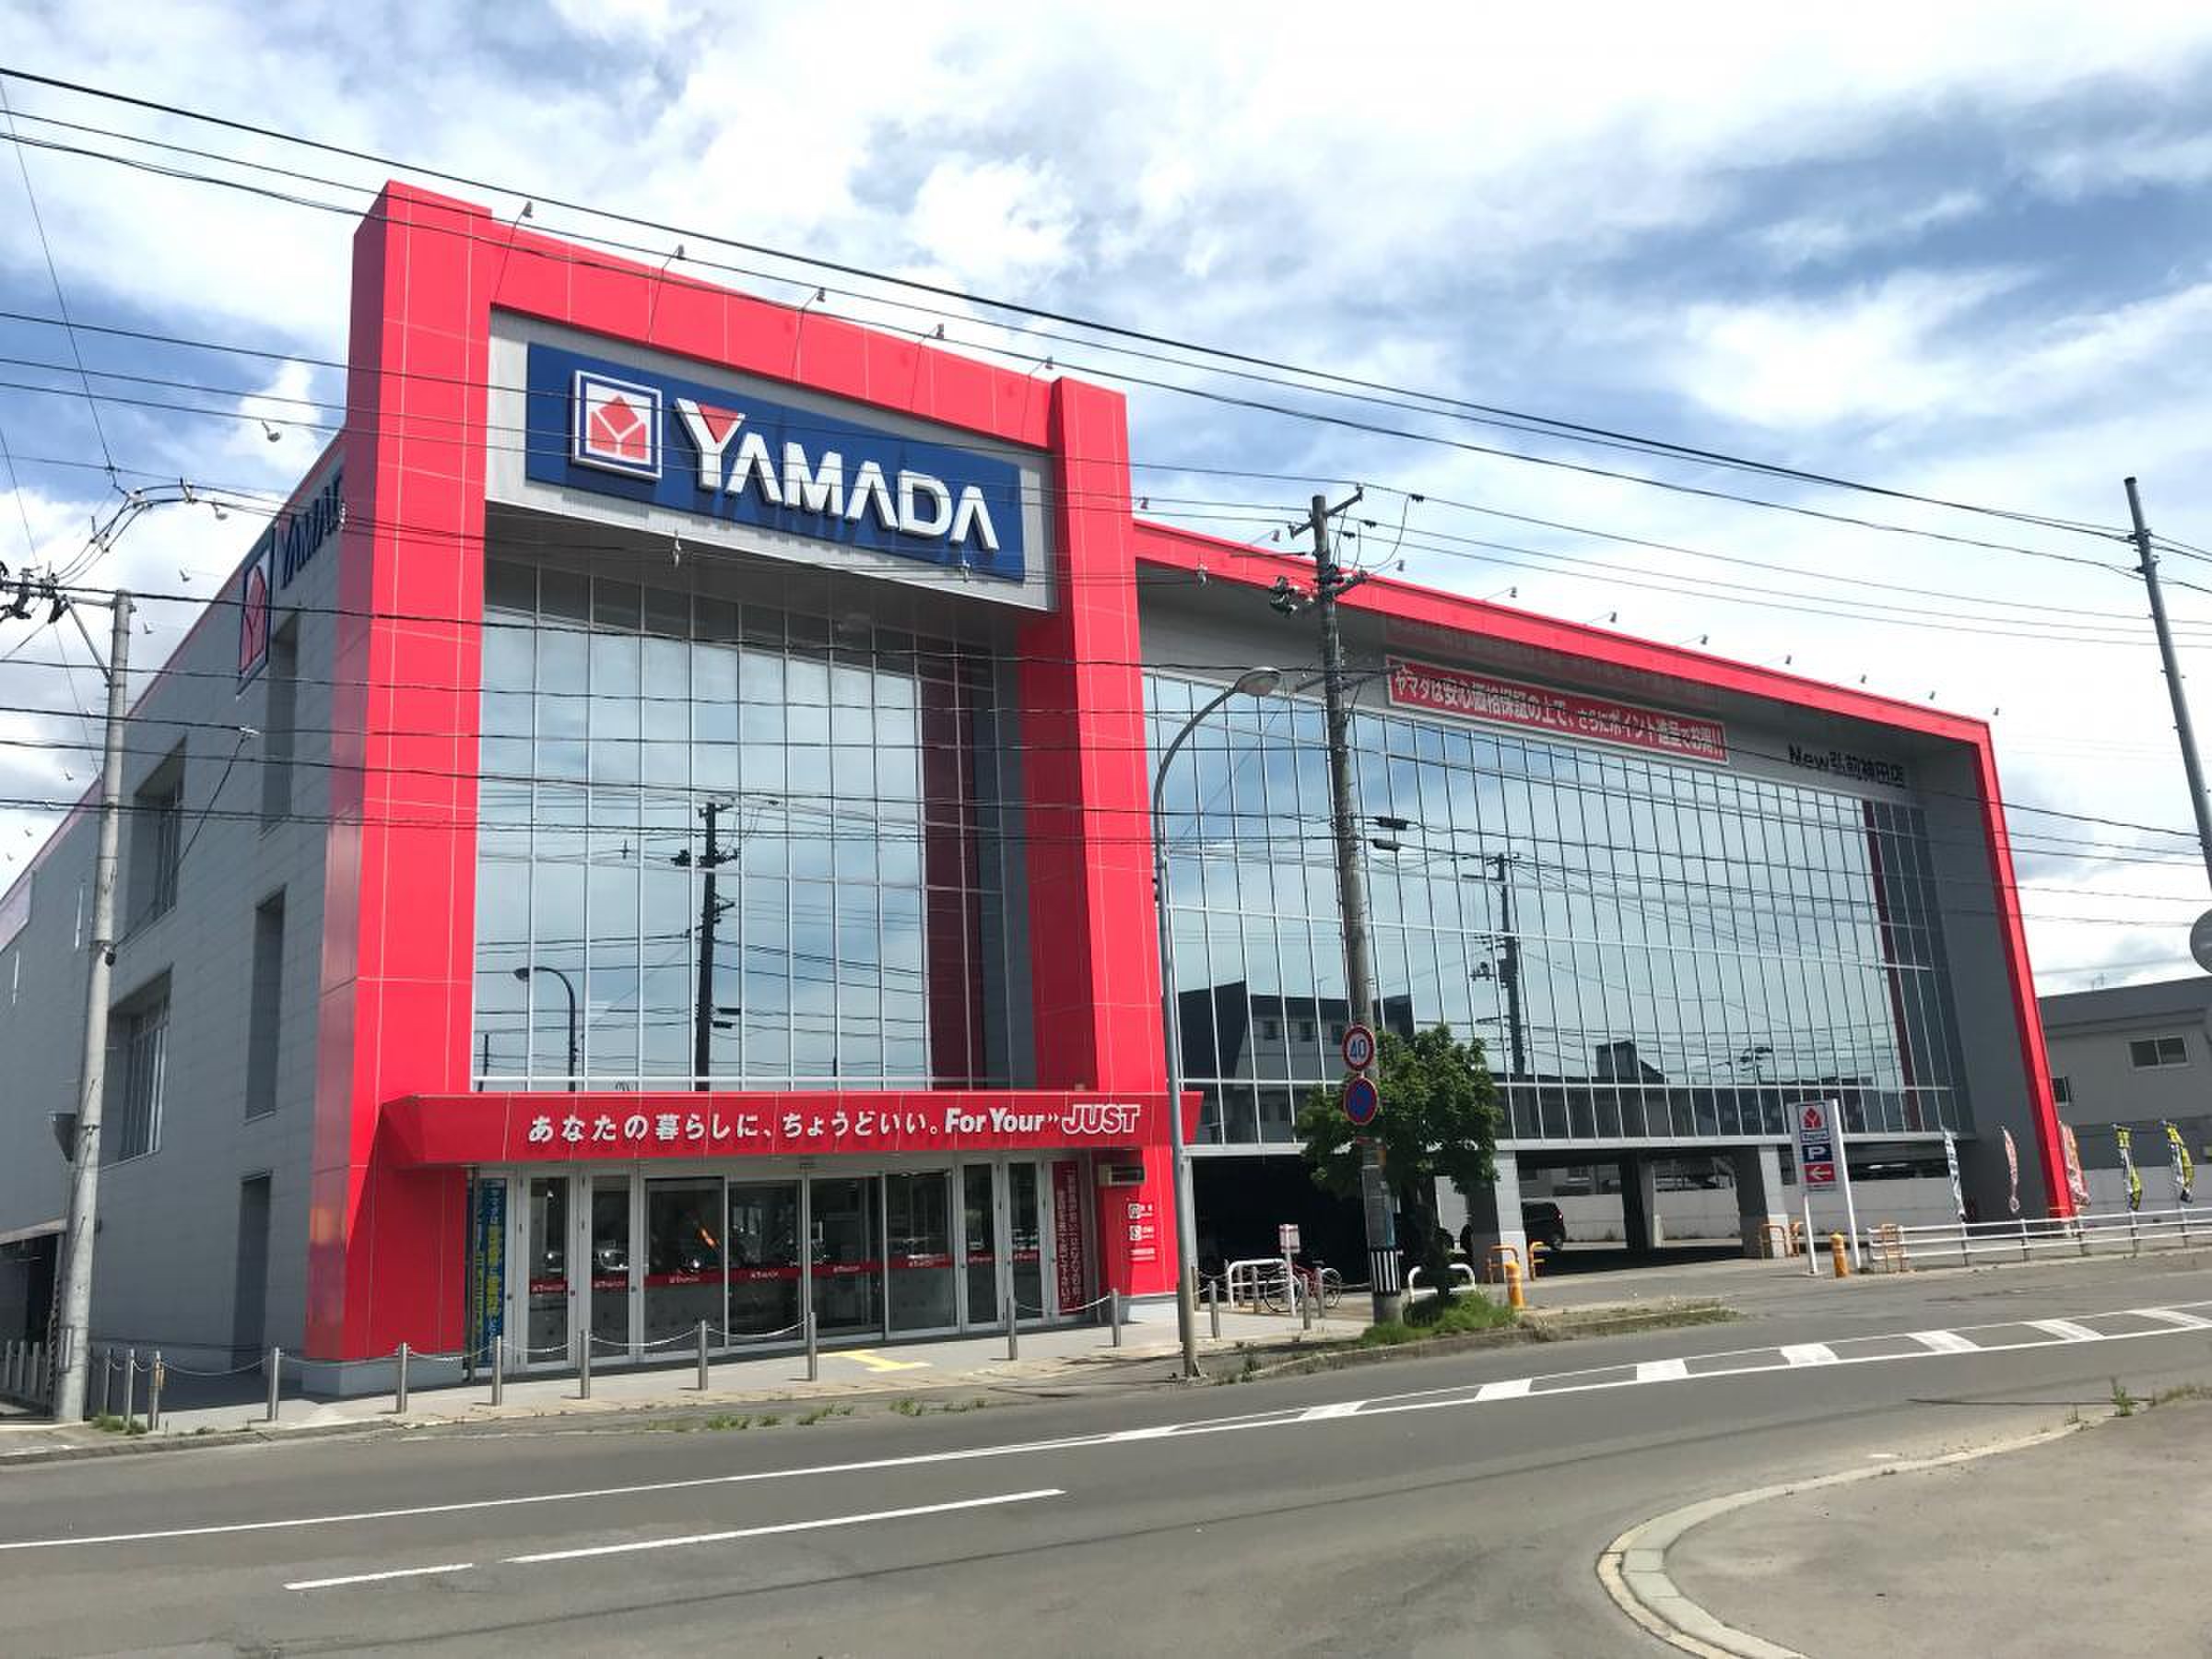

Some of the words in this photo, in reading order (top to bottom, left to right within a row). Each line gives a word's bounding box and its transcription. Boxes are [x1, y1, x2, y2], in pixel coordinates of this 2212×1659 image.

[676, 397, 999, 551] YAMADA
[1350, 1039, 1367, 1058] 40
[528, 1111, 938, 1142] あなたの暮らしに、ちょうどいい。
[945, 1107, 987, 1134] For
[1062, 1104, 1141, 1135] JUST
[1808, 1147, 1826, 1160] P
